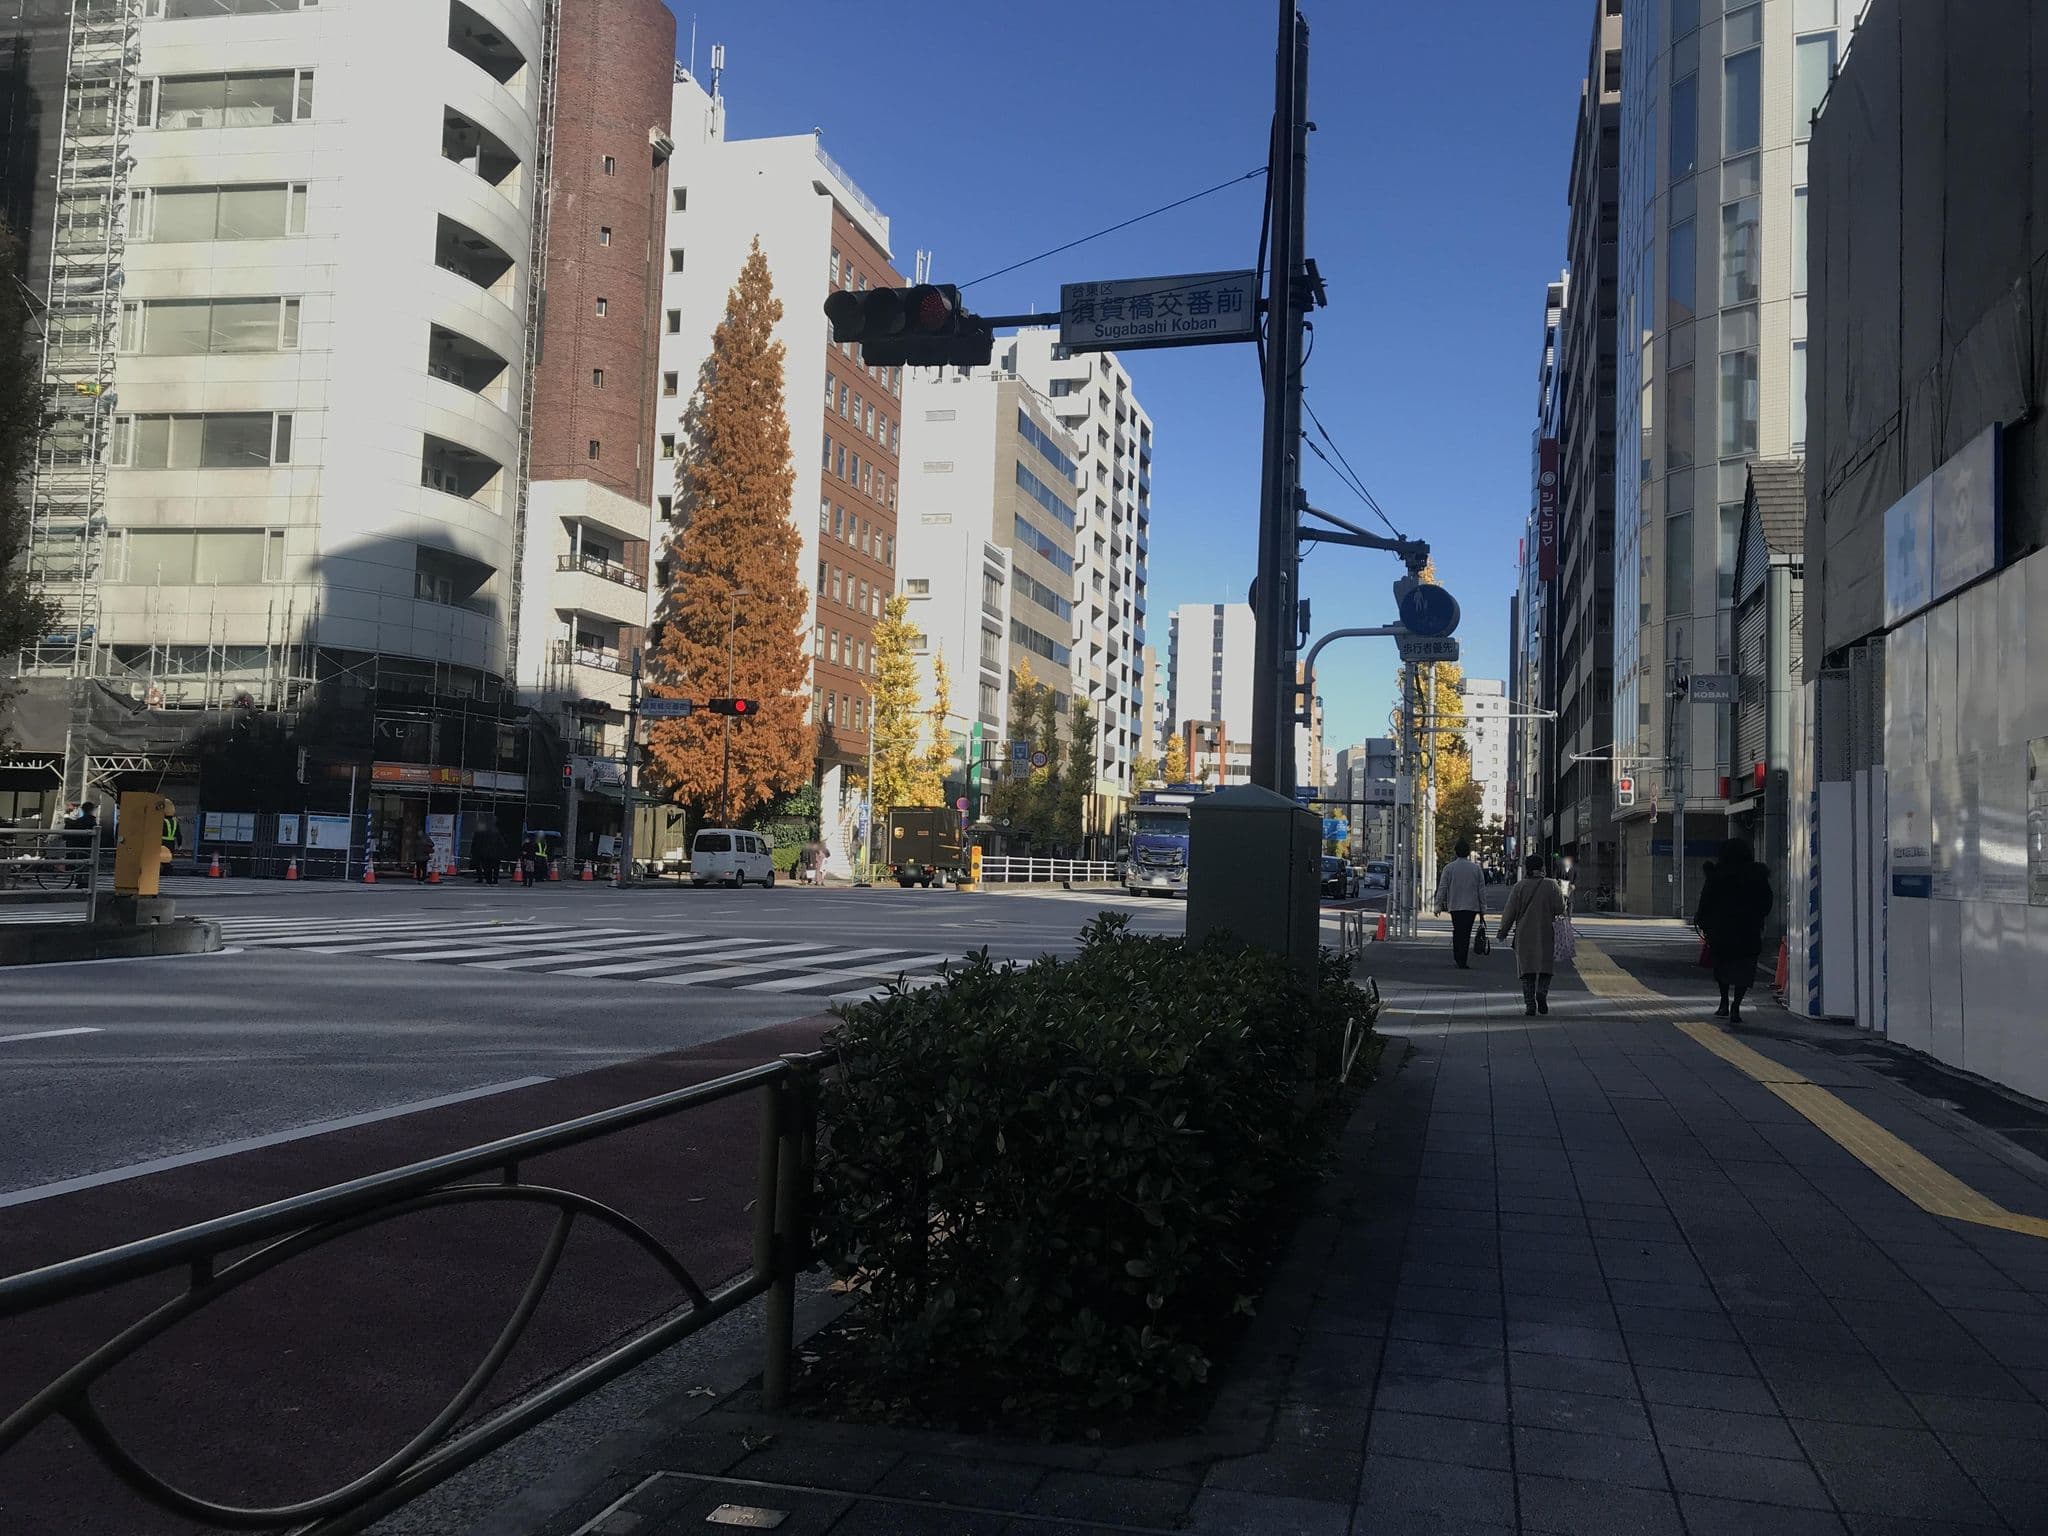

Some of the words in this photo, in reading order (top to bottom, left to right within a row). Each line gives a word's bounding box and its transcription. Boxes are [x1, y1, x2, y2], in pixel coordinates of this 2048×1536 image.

[1071, 286, 1244, 325] 須賀橋交番前
[1095, 318, 1167, 339] Sugabashi
[1172, 316, 1217, 333] Koban
[1402, 640, 1454, 655] 歩行者優先
[1693, 690, 1729, 698] KOBAN
